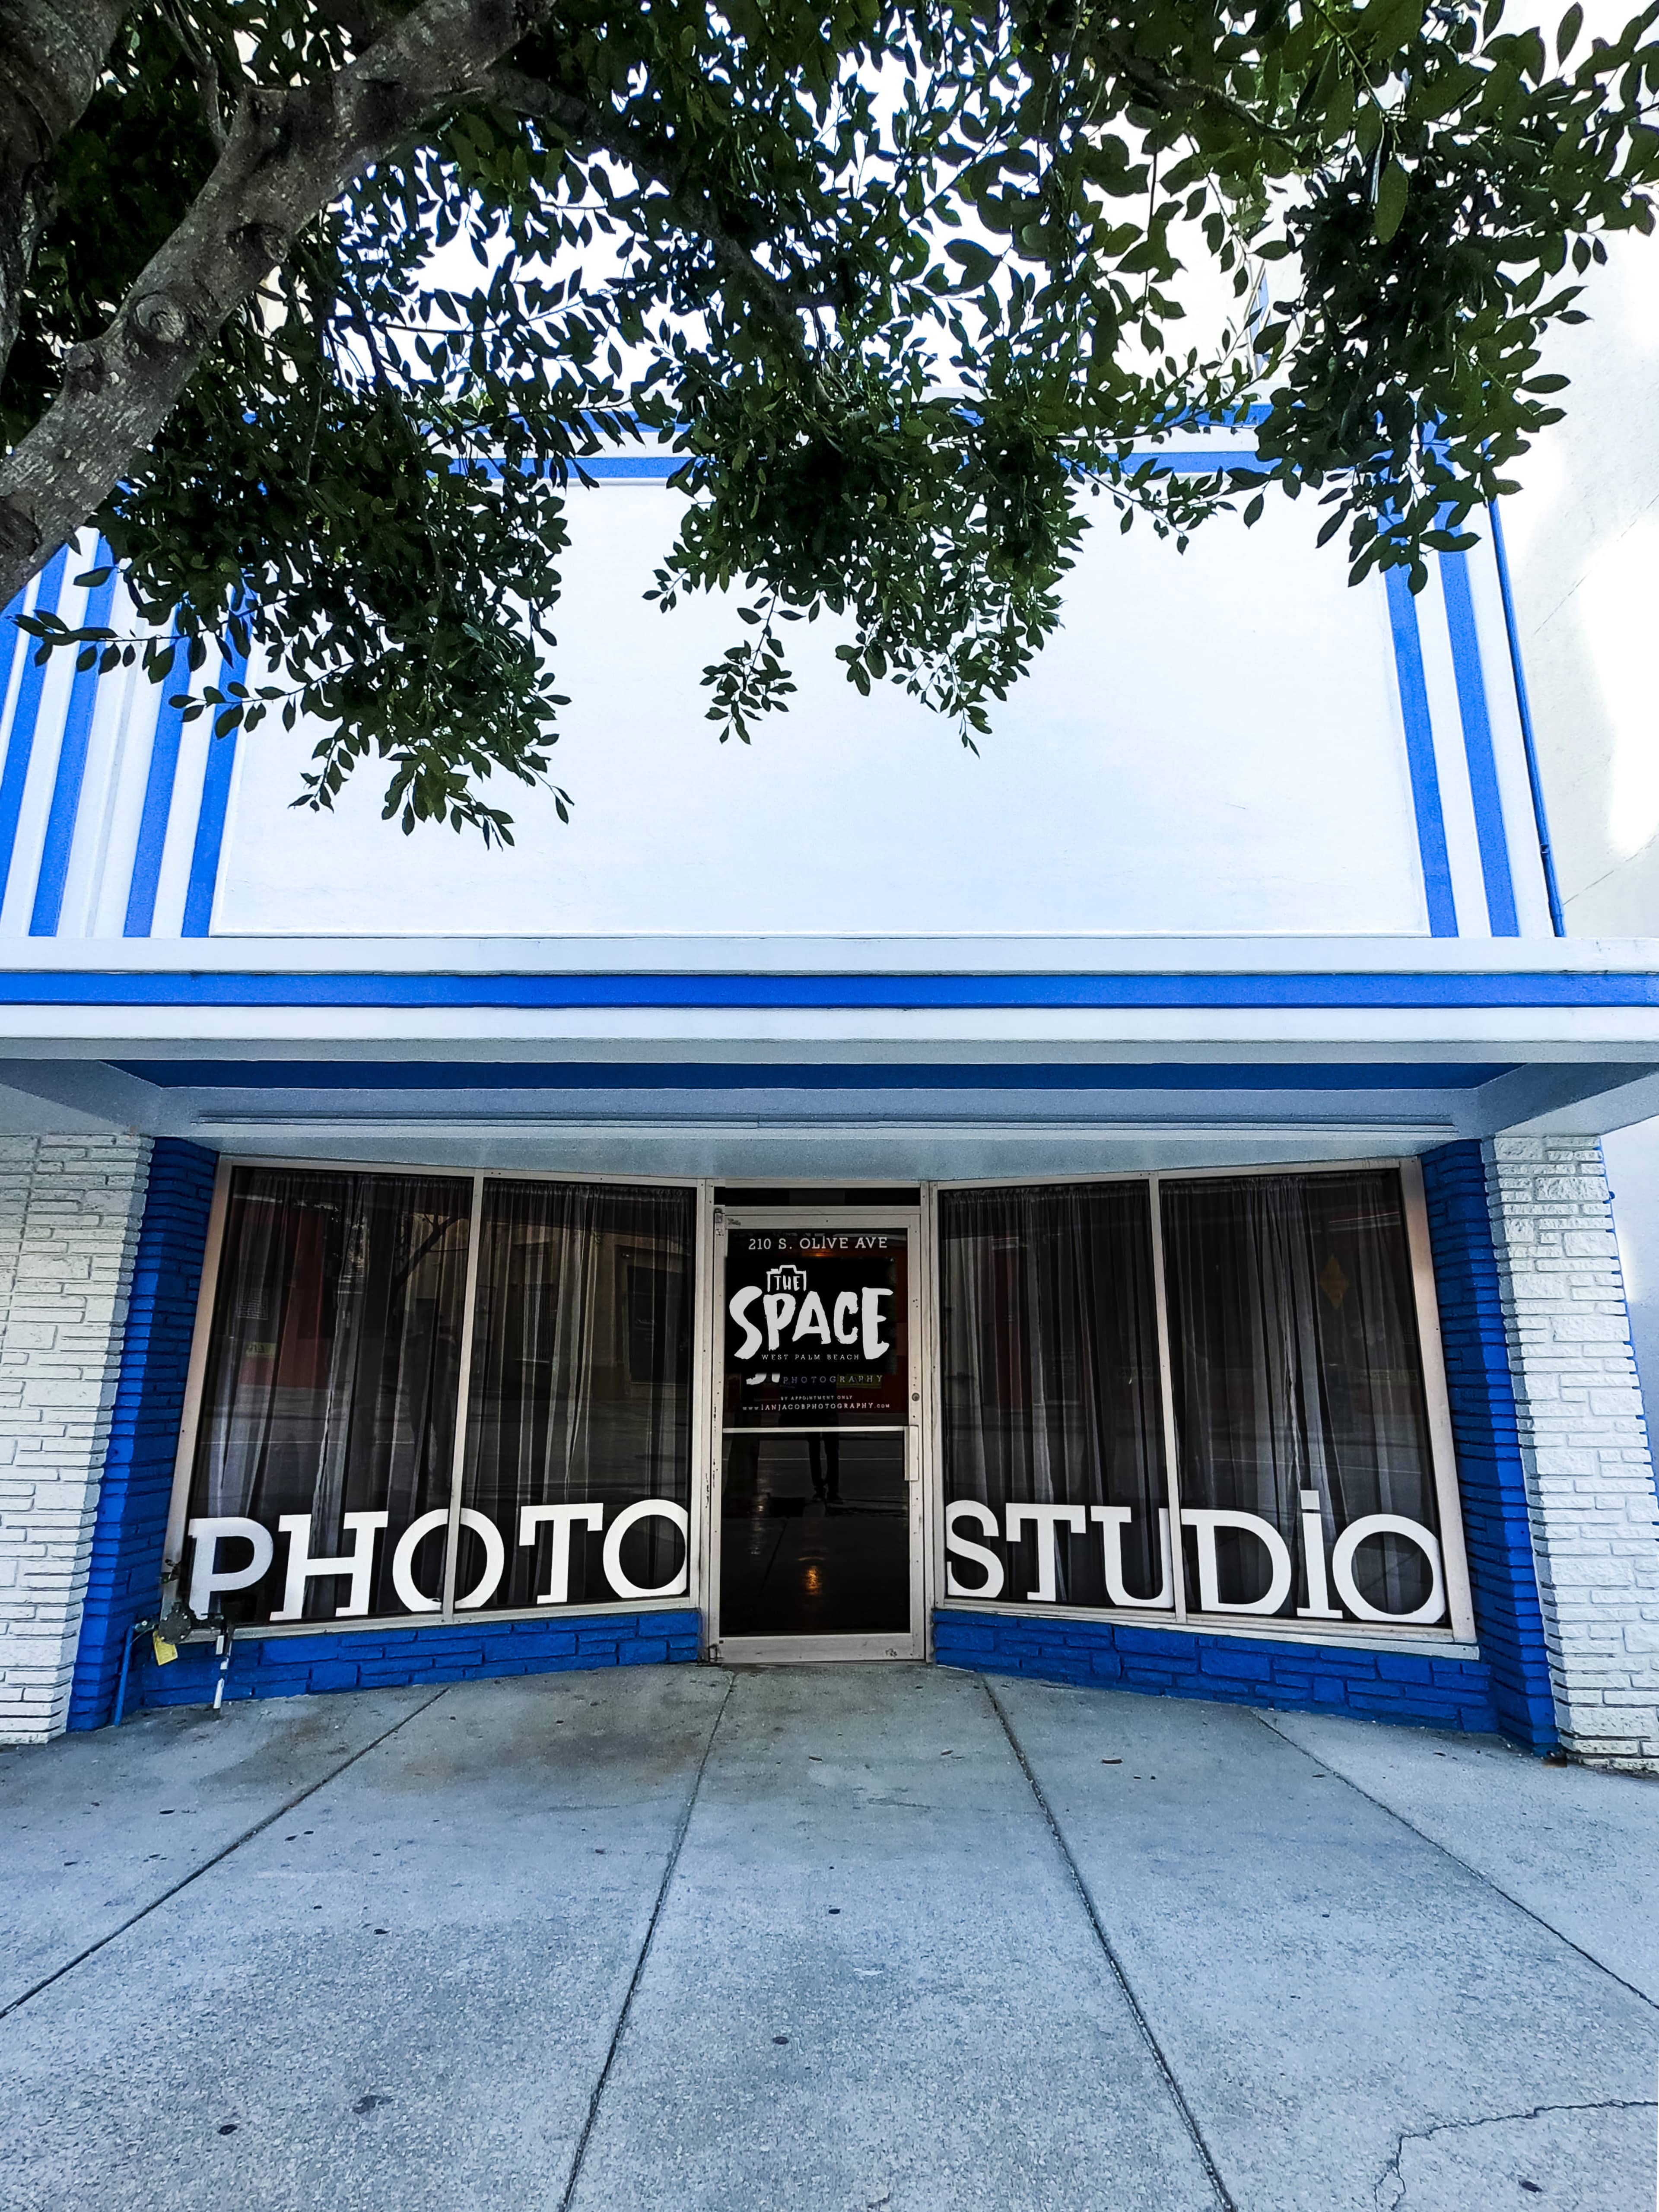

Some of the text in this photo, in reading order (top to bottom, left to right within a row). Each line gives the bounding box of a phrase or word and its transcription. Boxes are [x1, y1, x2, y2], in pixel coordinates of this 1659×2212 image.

[749, 1236, 887, 1249] 210 S. OLIVE AVE
[774, 1275, 800, 1291] THE
[729, 1286, 893, 1359] SPACE
[783, 1375, 883, 1384] PHOTOGRAPHY
[188, 1499, 688, 1621] PHOTO
